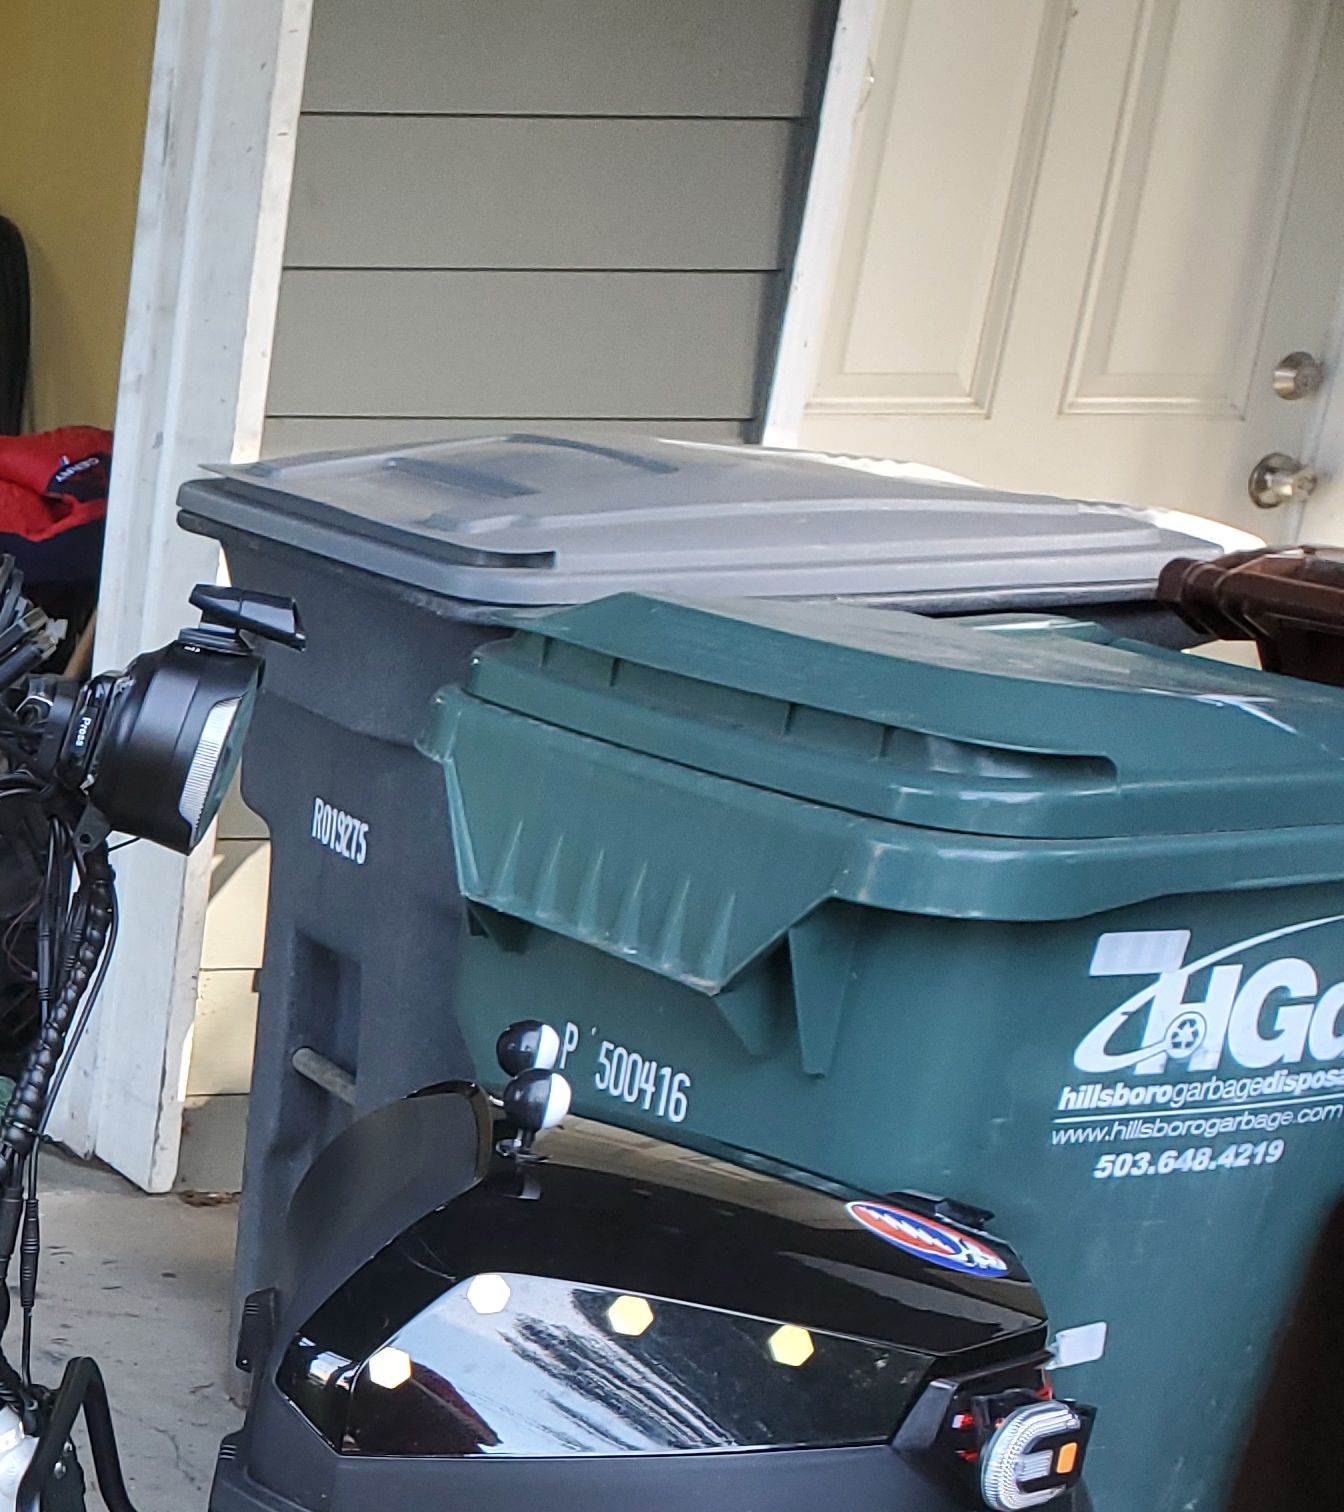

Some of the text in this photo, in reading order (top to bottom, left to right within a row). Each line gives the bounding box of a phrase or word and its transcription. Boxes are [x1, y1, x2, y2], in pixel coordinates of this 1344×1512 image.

[312, 797, 369, 865] R019275
[595, 1040, 691, 1123] 500416
[1051, 1104, 1344, 1146] www.hillsborogarbage.com
[1092, 1139, 1285, 1179] 503.648.4219
